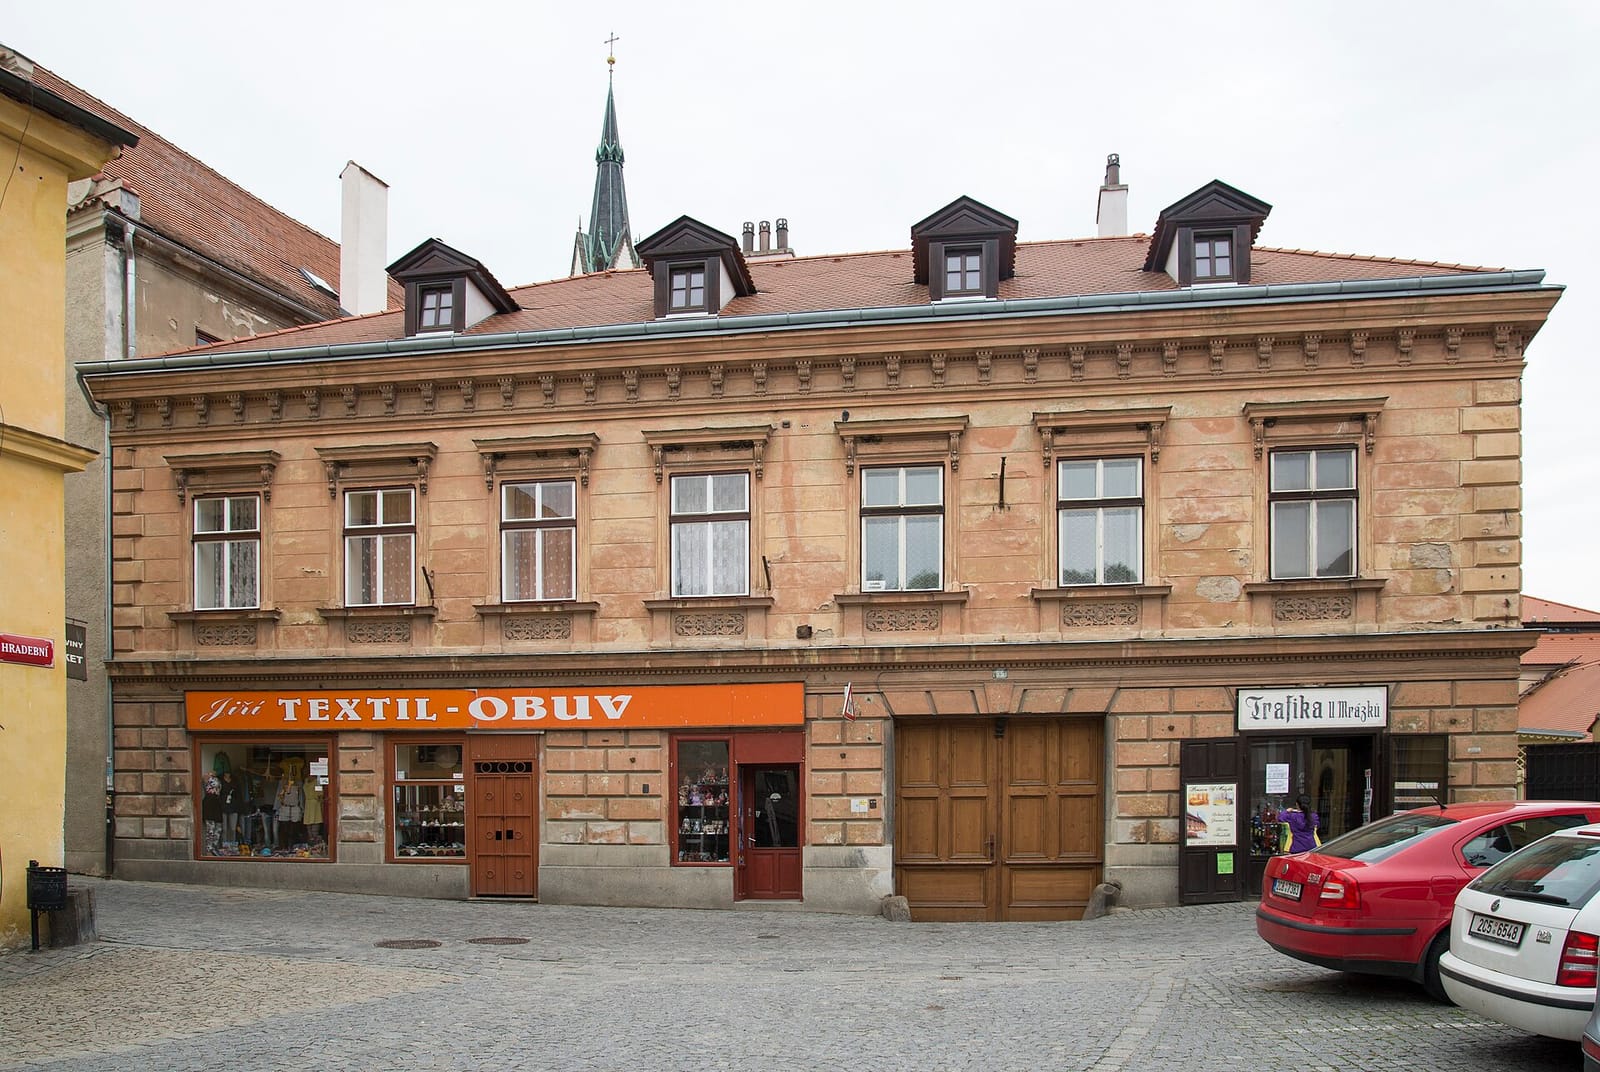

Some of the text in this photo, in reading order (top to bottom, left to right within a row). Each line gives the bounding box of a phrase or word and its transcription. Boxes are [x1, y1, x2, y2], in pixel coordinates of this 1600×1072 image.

[1, 643, 48, 657] HRADEBNÍ
[200, 697, 266, 723] Jiří
[278, 697, 437, 721] TEXTIL
[468, 695, 632, 721] OBUV
[1245, 695, 1323, 723] Trafika
[1328, 701, 1335, 719] U
[1477, 918, 1494, 934] 2C5
[1496, 922, 1519, 940] 6548
